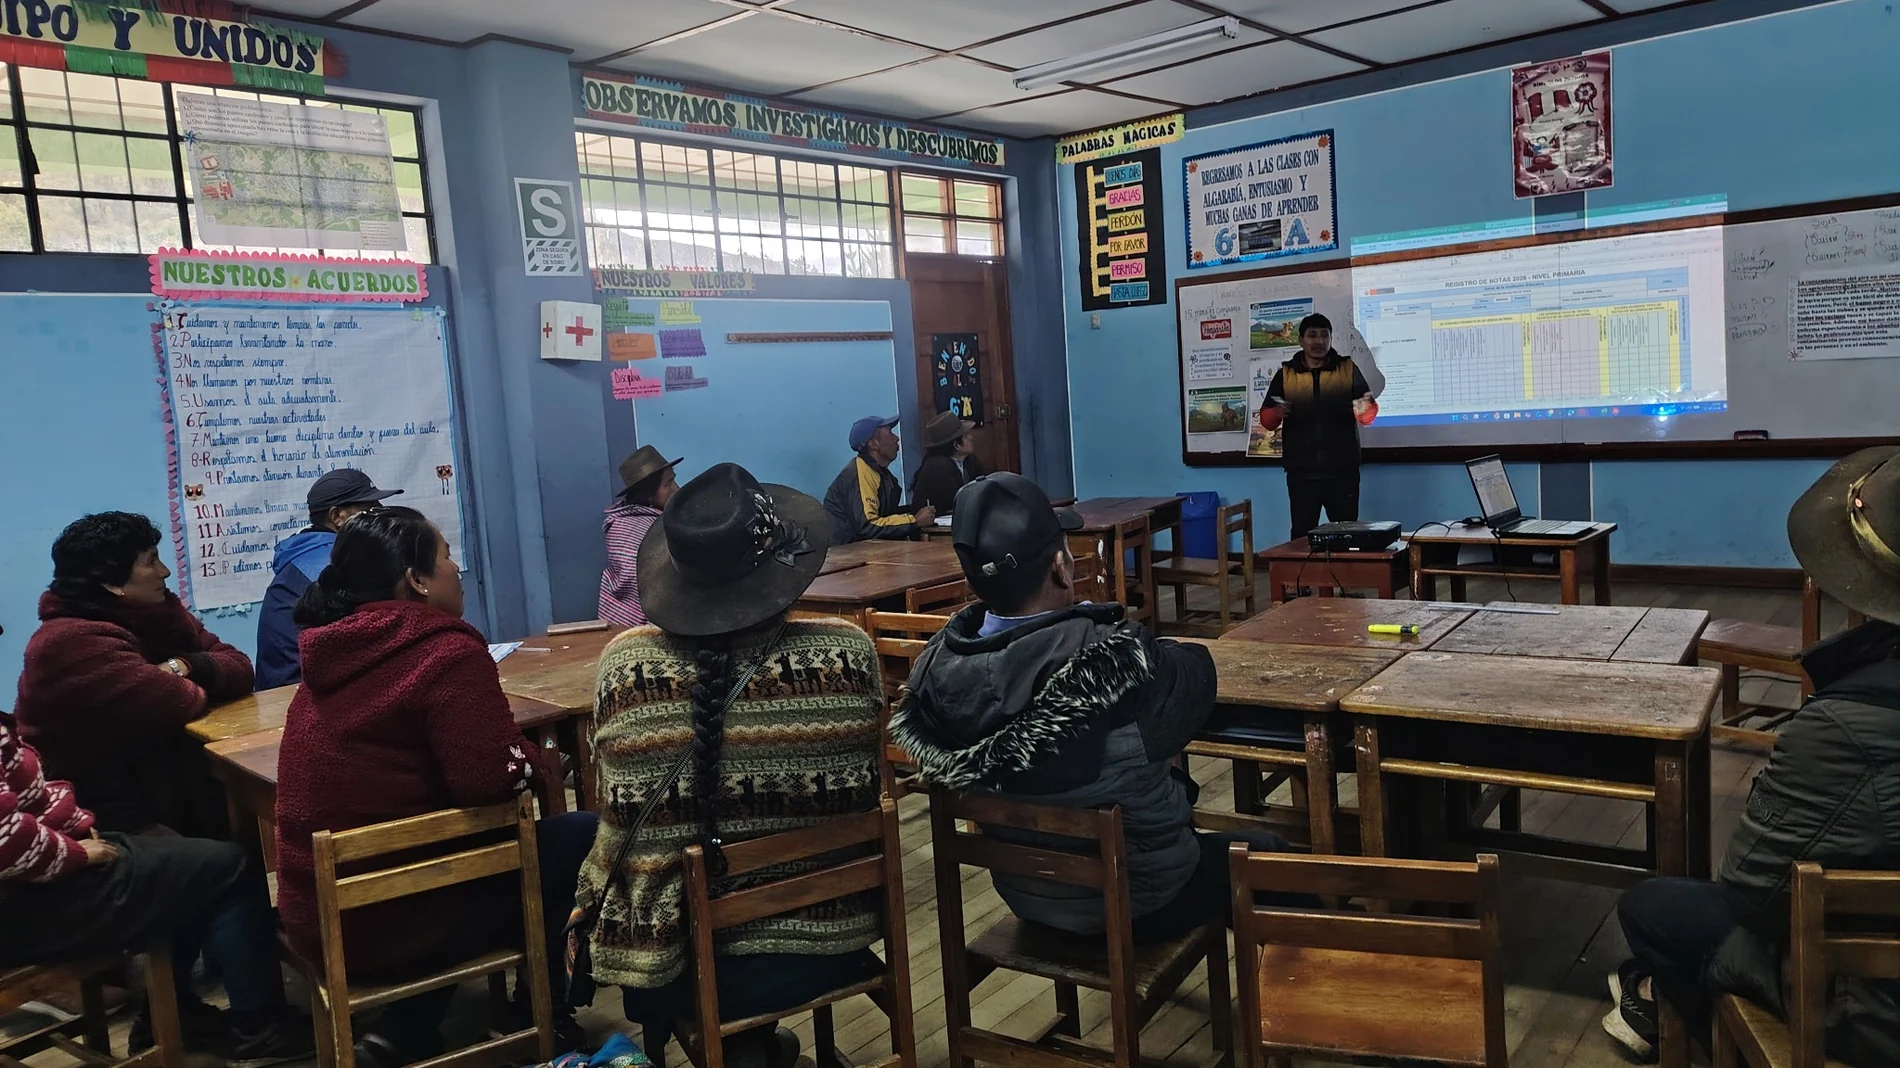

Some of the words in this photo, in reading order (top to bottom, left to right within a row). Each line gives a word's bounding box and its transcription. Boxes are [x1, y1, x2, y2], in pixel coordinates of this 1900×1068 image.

[107, 8, 140, 50] Y
[172, 15, 318, 74] UNIDOS
[746, 105, 882, 149] INVESTIGAMOS
[880, 125, 897, 150] Y
[896, 128, 999, 165] DESCUBRIMOS
[1061, 135, 1115, 157] PALABRAS
[1201, 163, 1242, 186] REGRESAMOS
[1248, 161, 1254, 177] A
[1258, 157, 1274, 175] LAS
[1277, 152, 1302, 171] CLASES
[1304, 149, 1319, 166] CON
[1108, 187, 1141, 206] GRACIAS
[1203, 182, 1247, 208] ALGARABÍA,
[1249, 177, 1293, 199] ENTUSIASMO
[1299, 175, 1308, 191] Y
[531, 188, 566, 237] S
[1205, 208, 1229, 226] MUCHAS
[1232, 204, 1257, 222] GANAS
[1261, 202, 1272, 218] DE
[1277, 195, 1319, 216] APRENDER
[1111, 213, 1142, 229] PERDÓN
[1285, 218, 1310, 246] A
[1124, 238, 1145, 250] FAVOR
[163, 261, 287, 288] NUESTROS
[307, 268, 418, 294] ACUERDOS
[1112, 263, 1143, 277] PERMISO
[1445, 279, 1477, 288] REGISTRO
[1489, 276, 1511, 285] NOTAS
[1532, 272, 1551, 280] NIVEL
[1552, 270, 1586, 278] PRIMARIA
[602, 271, 672, 288] NUESTROS
[690, 272, 746, 289] VALORES
[222, 320, 230, 334] y
[240, 334, 286, 348] levantando
[296, 335, 304, 348] la
[252, 357, 288, 373] siempre.
[260, 373, 294, 386] nuestros
[369, 430, 375, 443] y
[404, 422, 415, 435] del
[272, 448, 306, 461] horario
[312, 444, 321, 459] de
